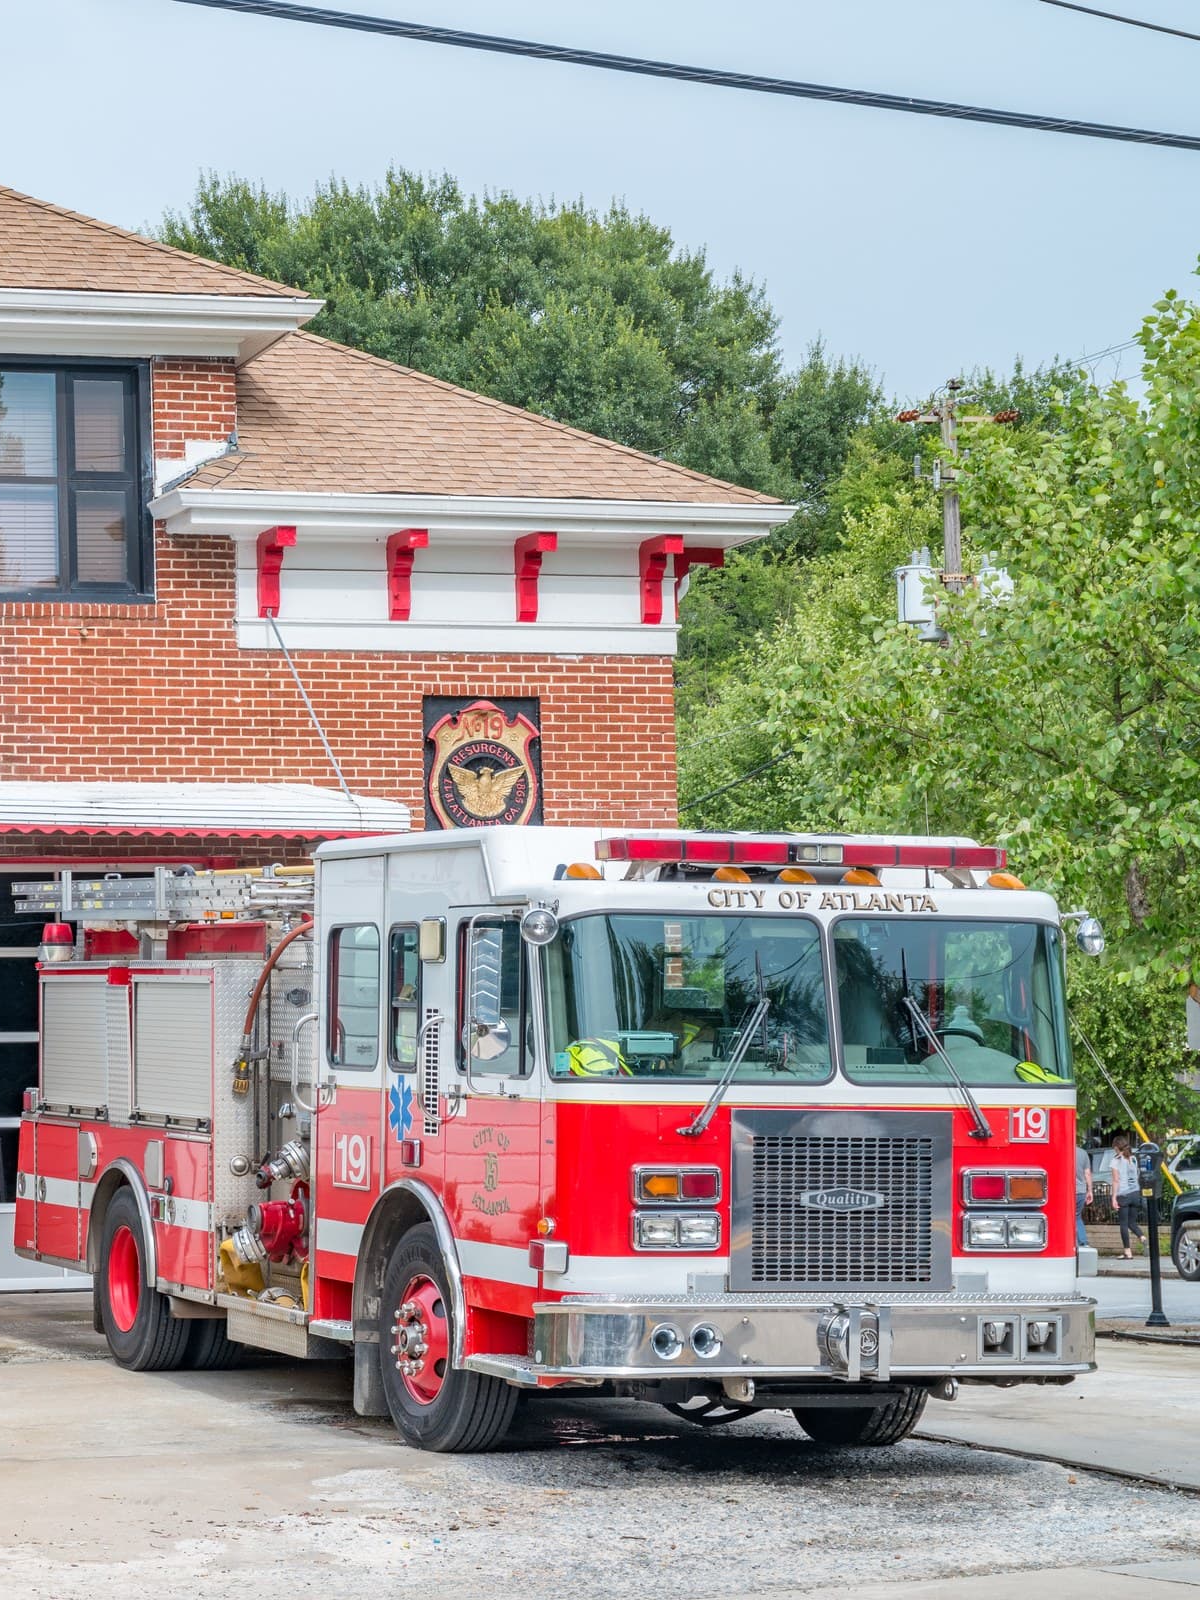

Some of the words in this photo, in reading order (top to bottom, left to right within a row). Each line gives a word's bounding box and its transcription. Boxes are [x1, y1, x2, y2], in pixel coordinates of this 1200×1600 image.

[452, 743, 516, 767] RESURGENS
[707, 888, 766, 908] CITY
[778, 890, 812, 909] OF
[819, 892, 939, 912] ATLANTA
[1012, 1107, 1046, 1138] 19
[337, 1134, 366, 1184] 19
[816, 1192, 869, 1206] Quality
